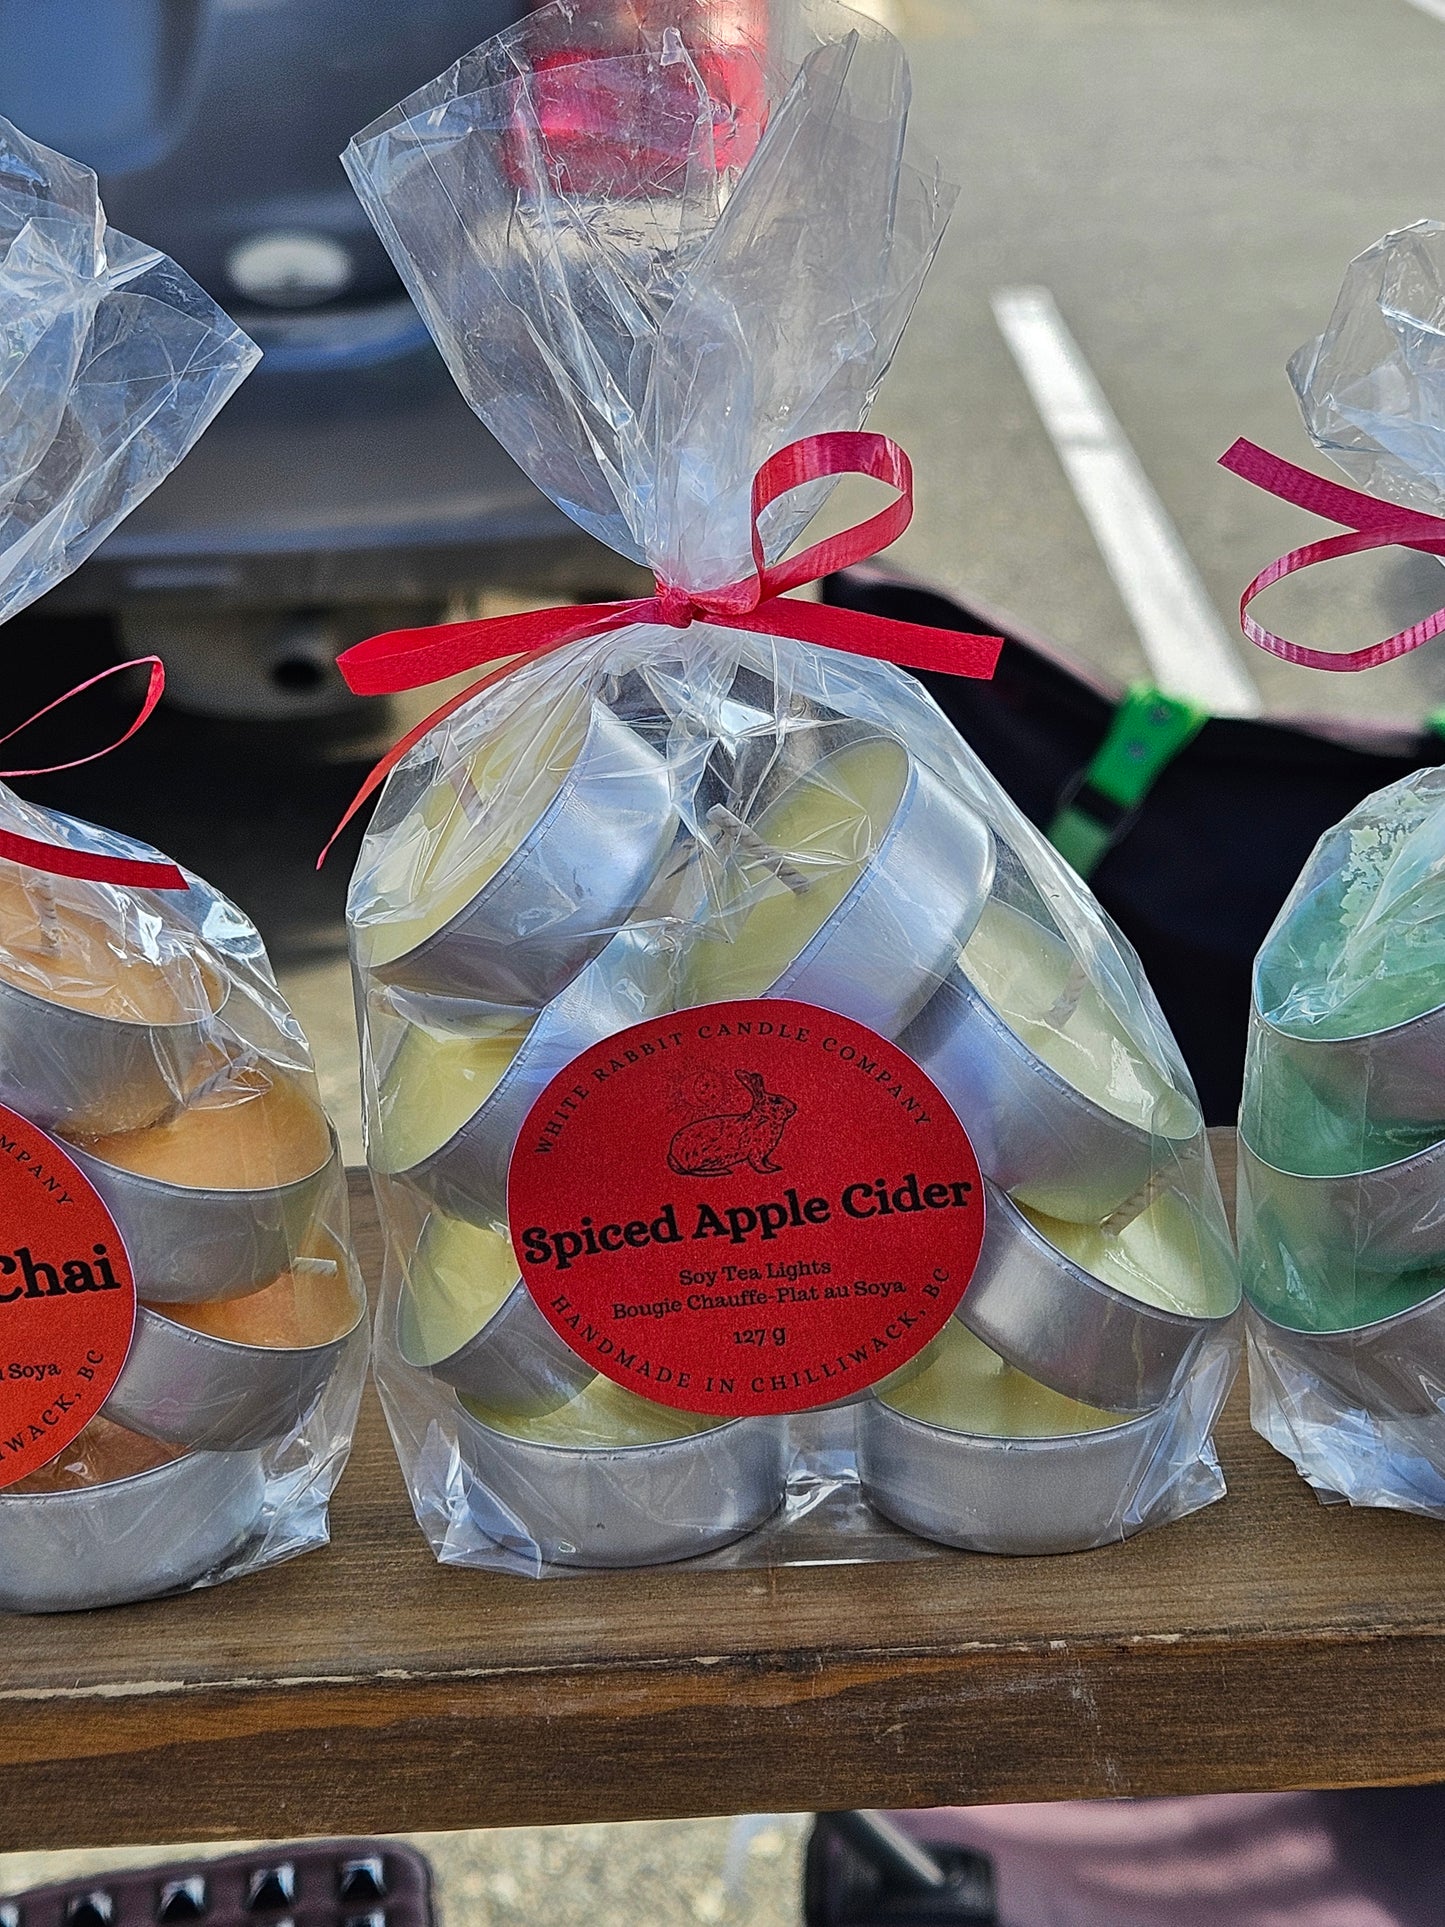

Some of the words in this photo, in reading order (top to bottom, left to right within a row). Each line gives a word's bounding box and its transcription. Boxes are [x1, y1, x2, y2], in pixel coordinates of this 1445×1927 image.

[534, 1087, 589, 1156] WHITE
[594, 1031, 683, 1082] RABBIT
[698, 1021, 810, 1043] CANDLE
[822, 1037, 931, 1127] COMPANY
[521, 1206, 683, 1270] Spiced
[692, 1188, 831, 1244] Apple
[841, 1173, 973, 1218] Cider
[680, 1269, 717, 1288] Soy
[722, 1266, 760, 1284] Tea
[767, 1259, 831, 1283] Lights
[612, 1298, 682, 1320] Bougie
[687, 1287, 818, 1311] Chauffe-Plat
[824, 1287, 851, 1300] au
[855, 1280, 907, 1300] Soya
[550, 1296, 691, 1389] HANDMADE
[706, 1378, 735, 1394] IN
[751, 1310, 926, 1394] CHILLIWACK,
[923, 1267, 950, 1299] BC
[732, 1330, 766, 1346] 127
[773, 1327, 786, 1347] g
[8, 1363, 61, 1382] Soya
[77, 1350, 104, 1381] BC
